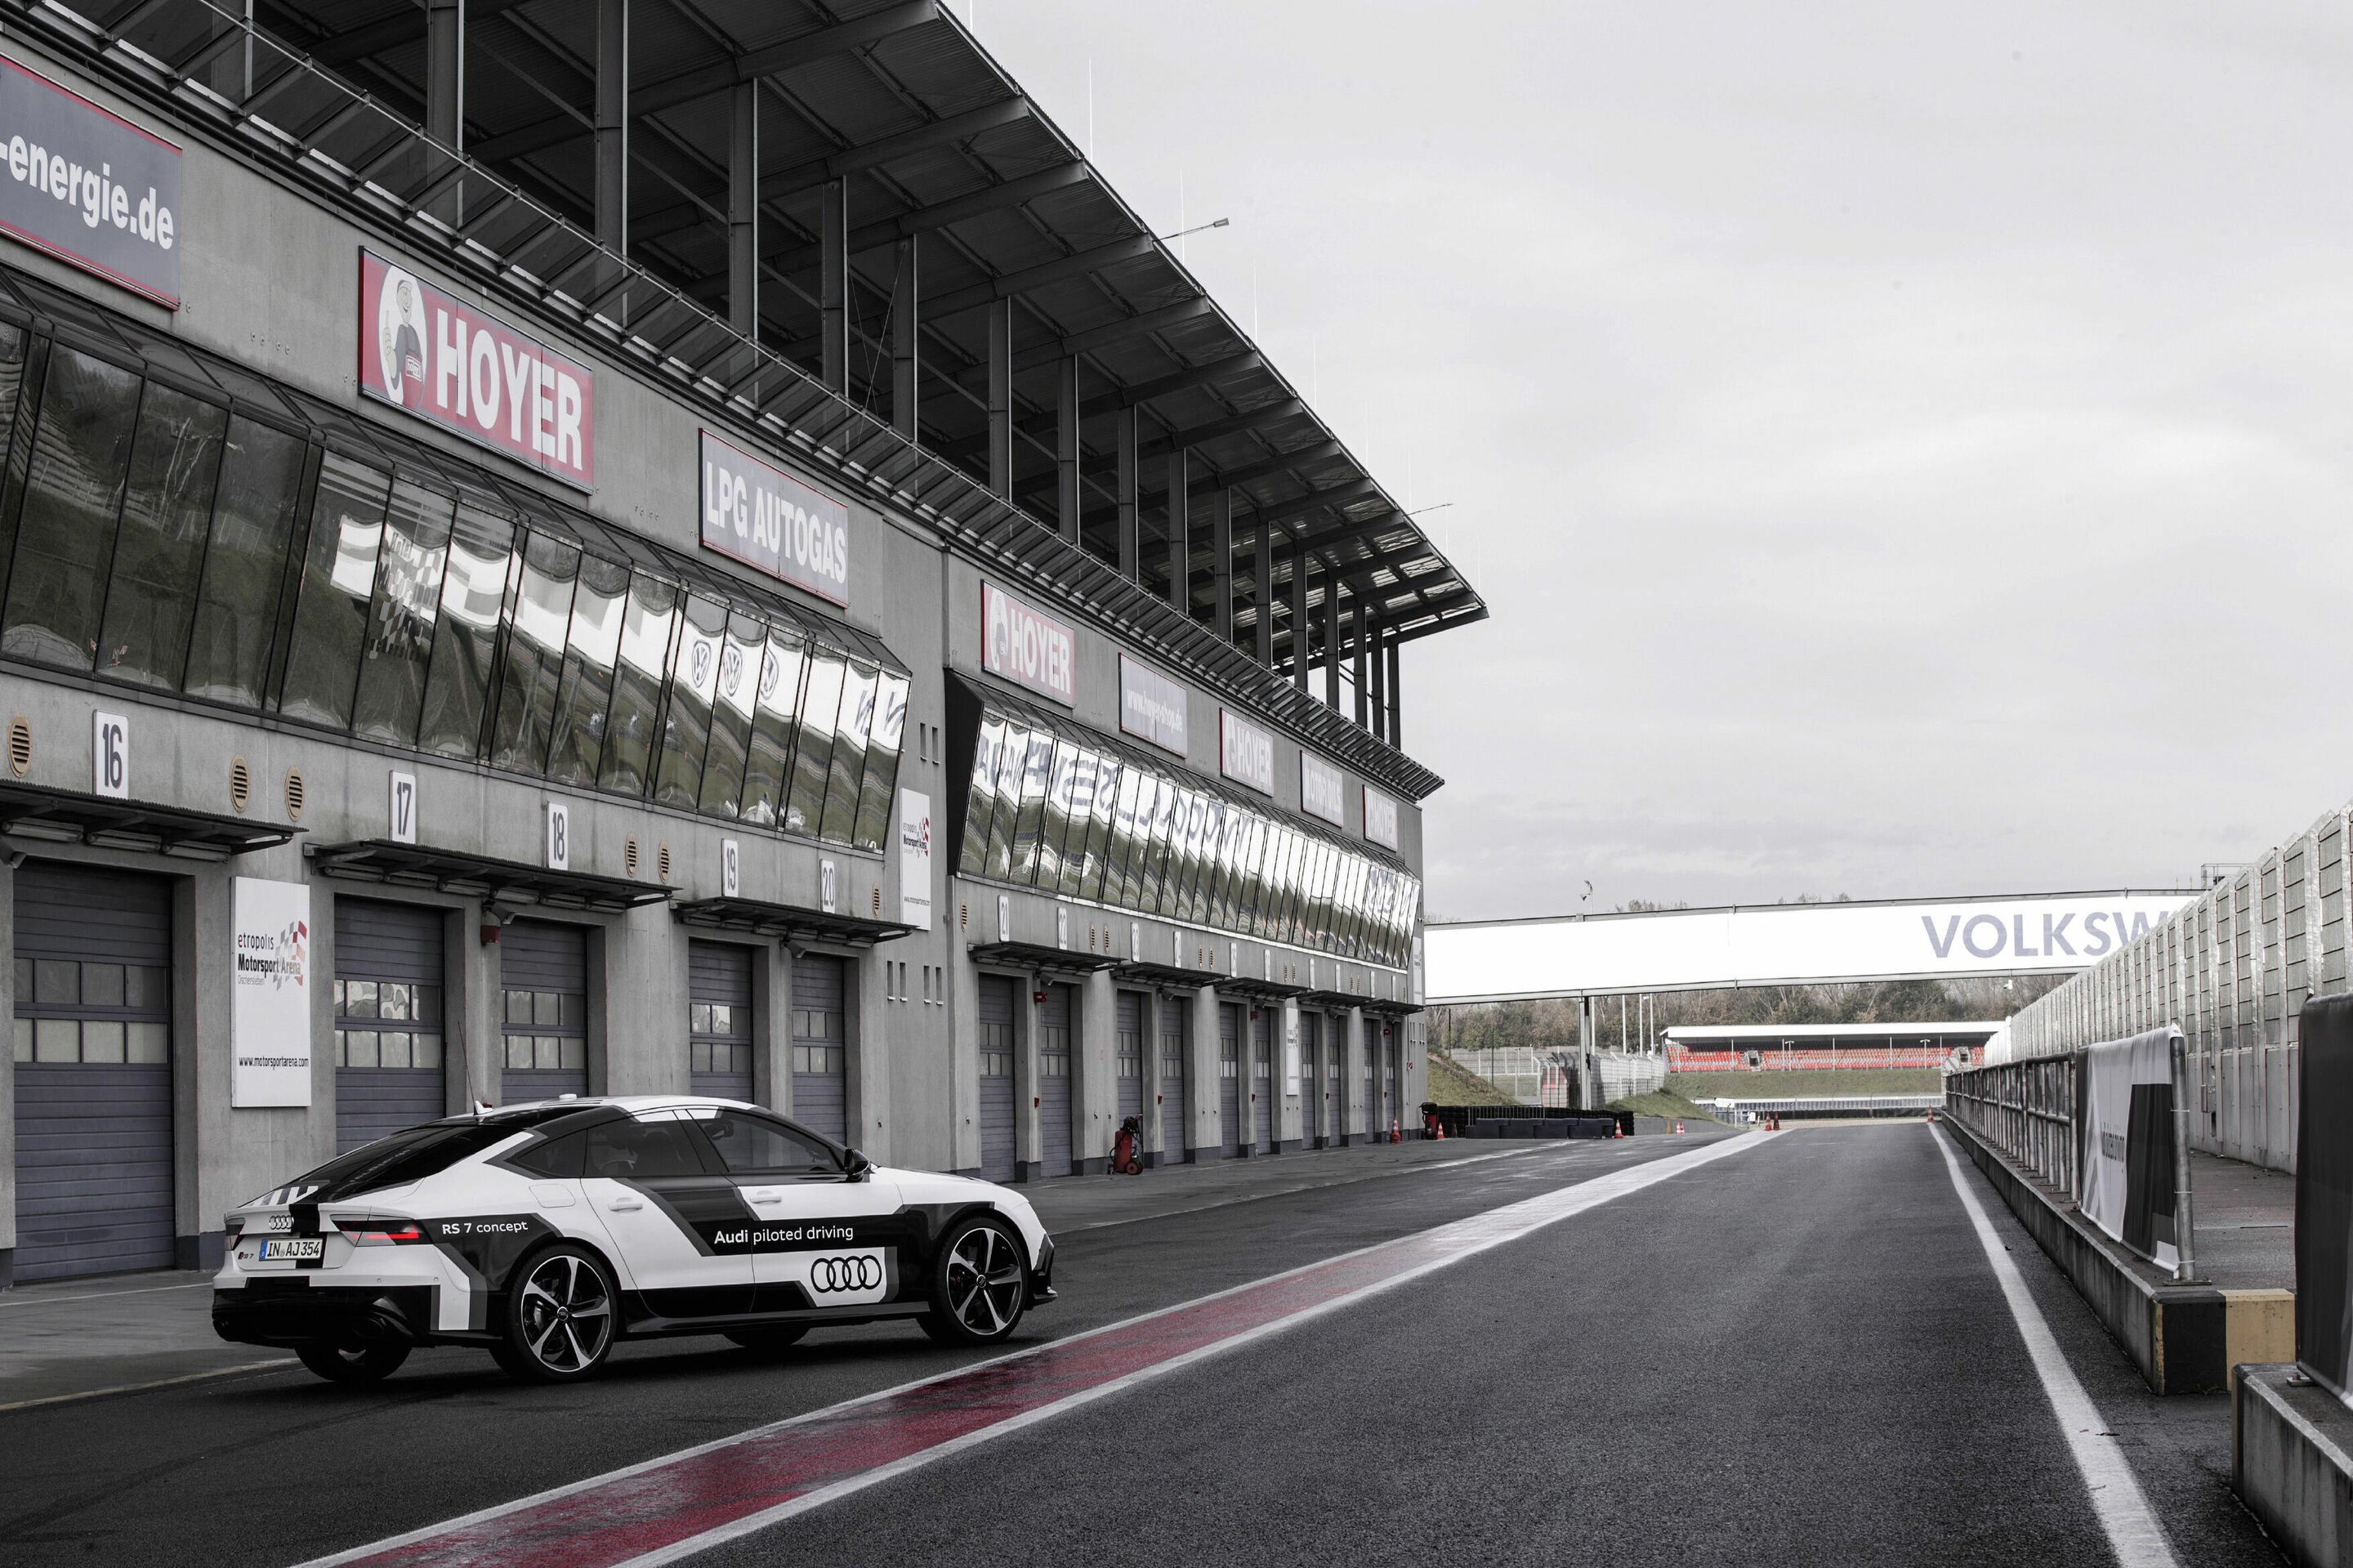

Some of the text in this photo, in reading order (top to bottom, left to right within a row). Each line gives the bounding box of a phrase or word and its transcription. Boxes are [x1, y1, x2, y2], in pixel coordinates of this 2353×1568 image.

[436, 307, 583, 471] HOYER
[707, 461, 846, 583] LPG AUTOGAS
[1011, 607, 1071, 695] HOYER
[102, 723, 123, 789] 16
[1238, 726, 1271, 787] HOYER
[397, 781, 412, 836] 17
[552, 812, 565, 862] 18
[726, 847, 736, 891] 19
[823, 867, 834, 907] 20
[1002, 901, 1008, 936] 21
[238, 931, 275, 951] etropolis
[238, 953, 301, 979] Motorsport Arena
[239, 1055, 309, 1071] www.motorsportarena.com
[442, 1221, 529, 1235] RS 7 concept
[714, 1225, 854, 1245] Audi piloted driving
[267, 1241, 320, 1258] IN AJ 354
